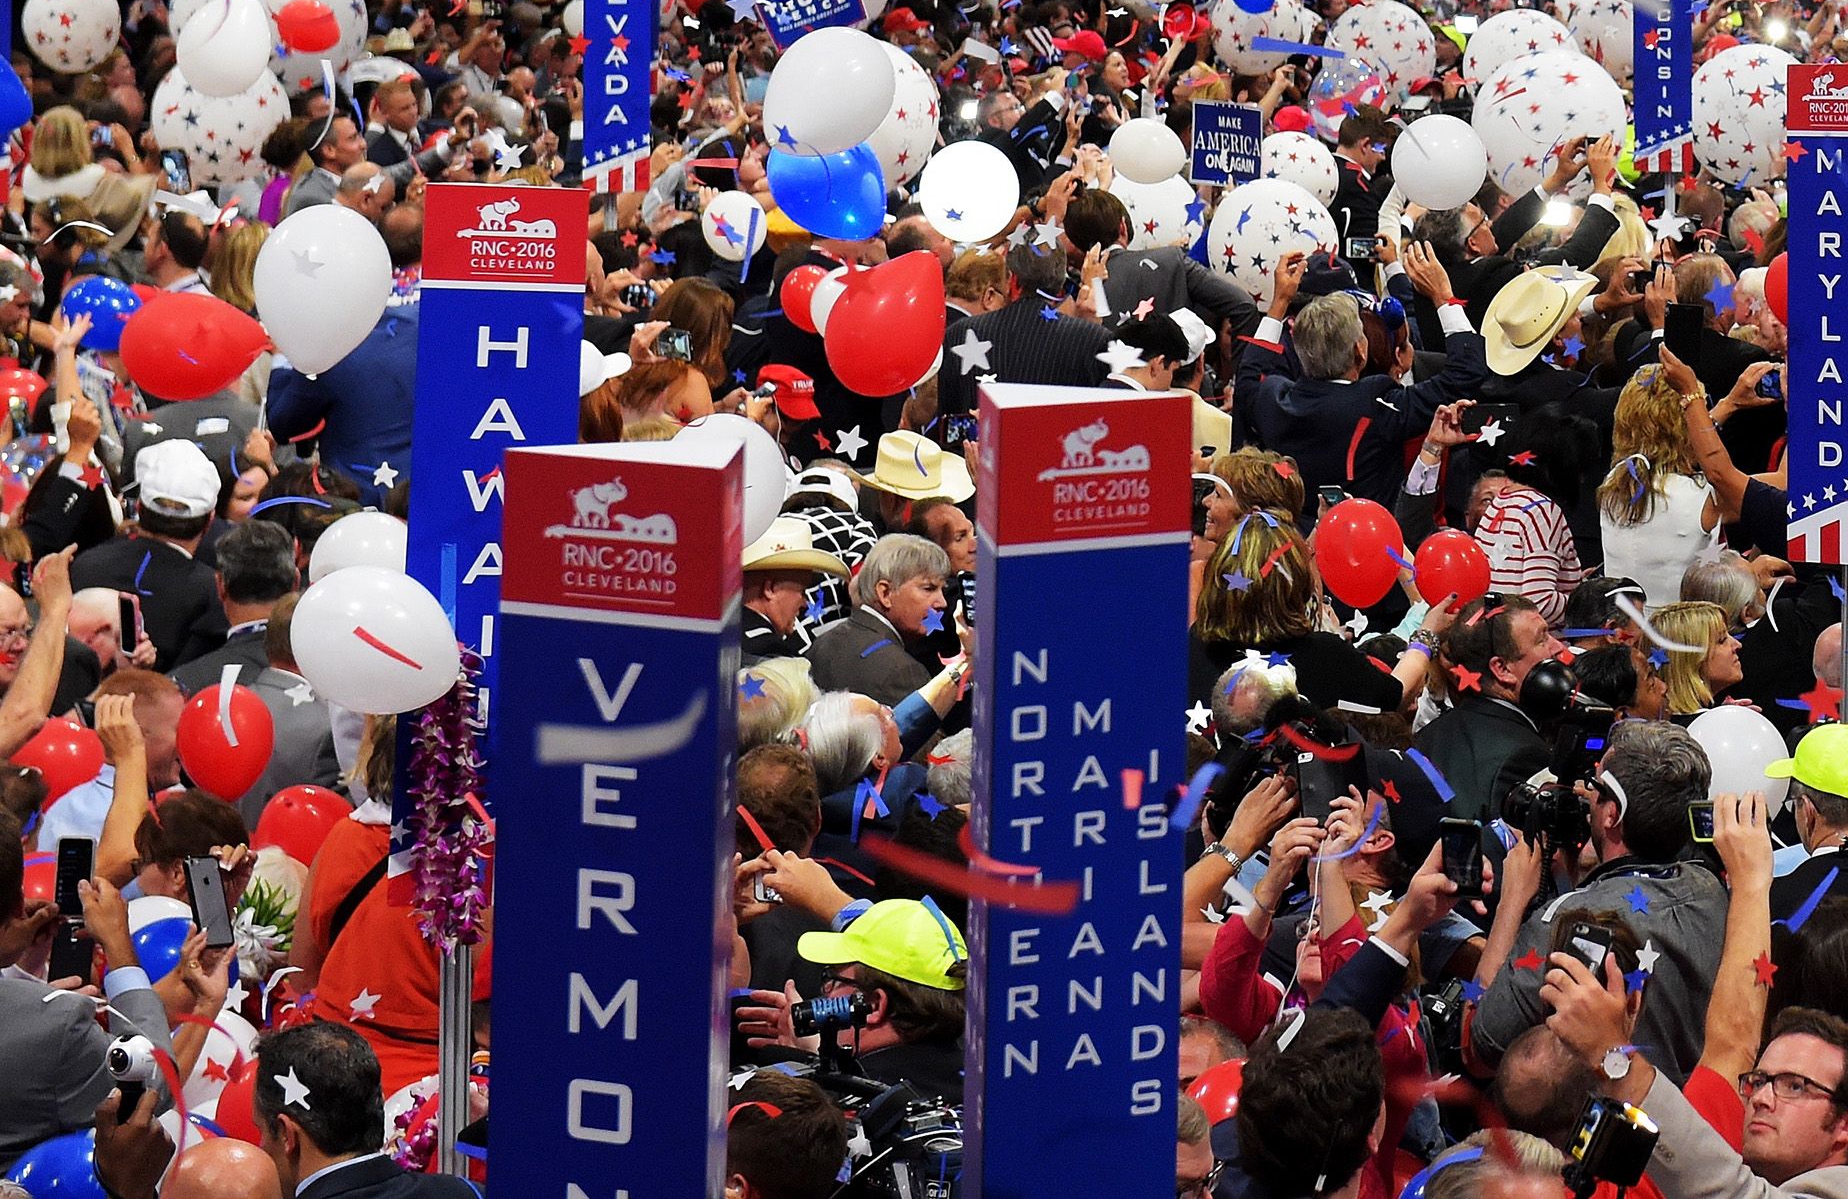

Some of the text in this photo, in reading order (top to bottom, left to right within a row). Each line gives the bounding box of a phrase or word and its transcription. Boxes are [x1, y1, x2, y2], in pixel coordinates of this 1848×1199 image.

[1194, 129, 1261, 157] AMERICA
[1218, 115, 1242, 130] MAKE
[1229, 155, 1255, 174] AGAIN
[471, 257, 556, 271] CLEVELAND
[1816, 148, 1843, 467] MARYLAND
[462, 326, 529, 737] HAWAII
[563, 569, 678, 595] CLEVELAND
[1053, 502, 1151, 523] CLEVELAND
[566, 657, 645, 1199] VERMO
[1004, 648, 1049, 1078] NORTERN
[1065, 697, 1112, 1071] MARIANA
[1130, 748, 1169, 1117] ISLANDS
